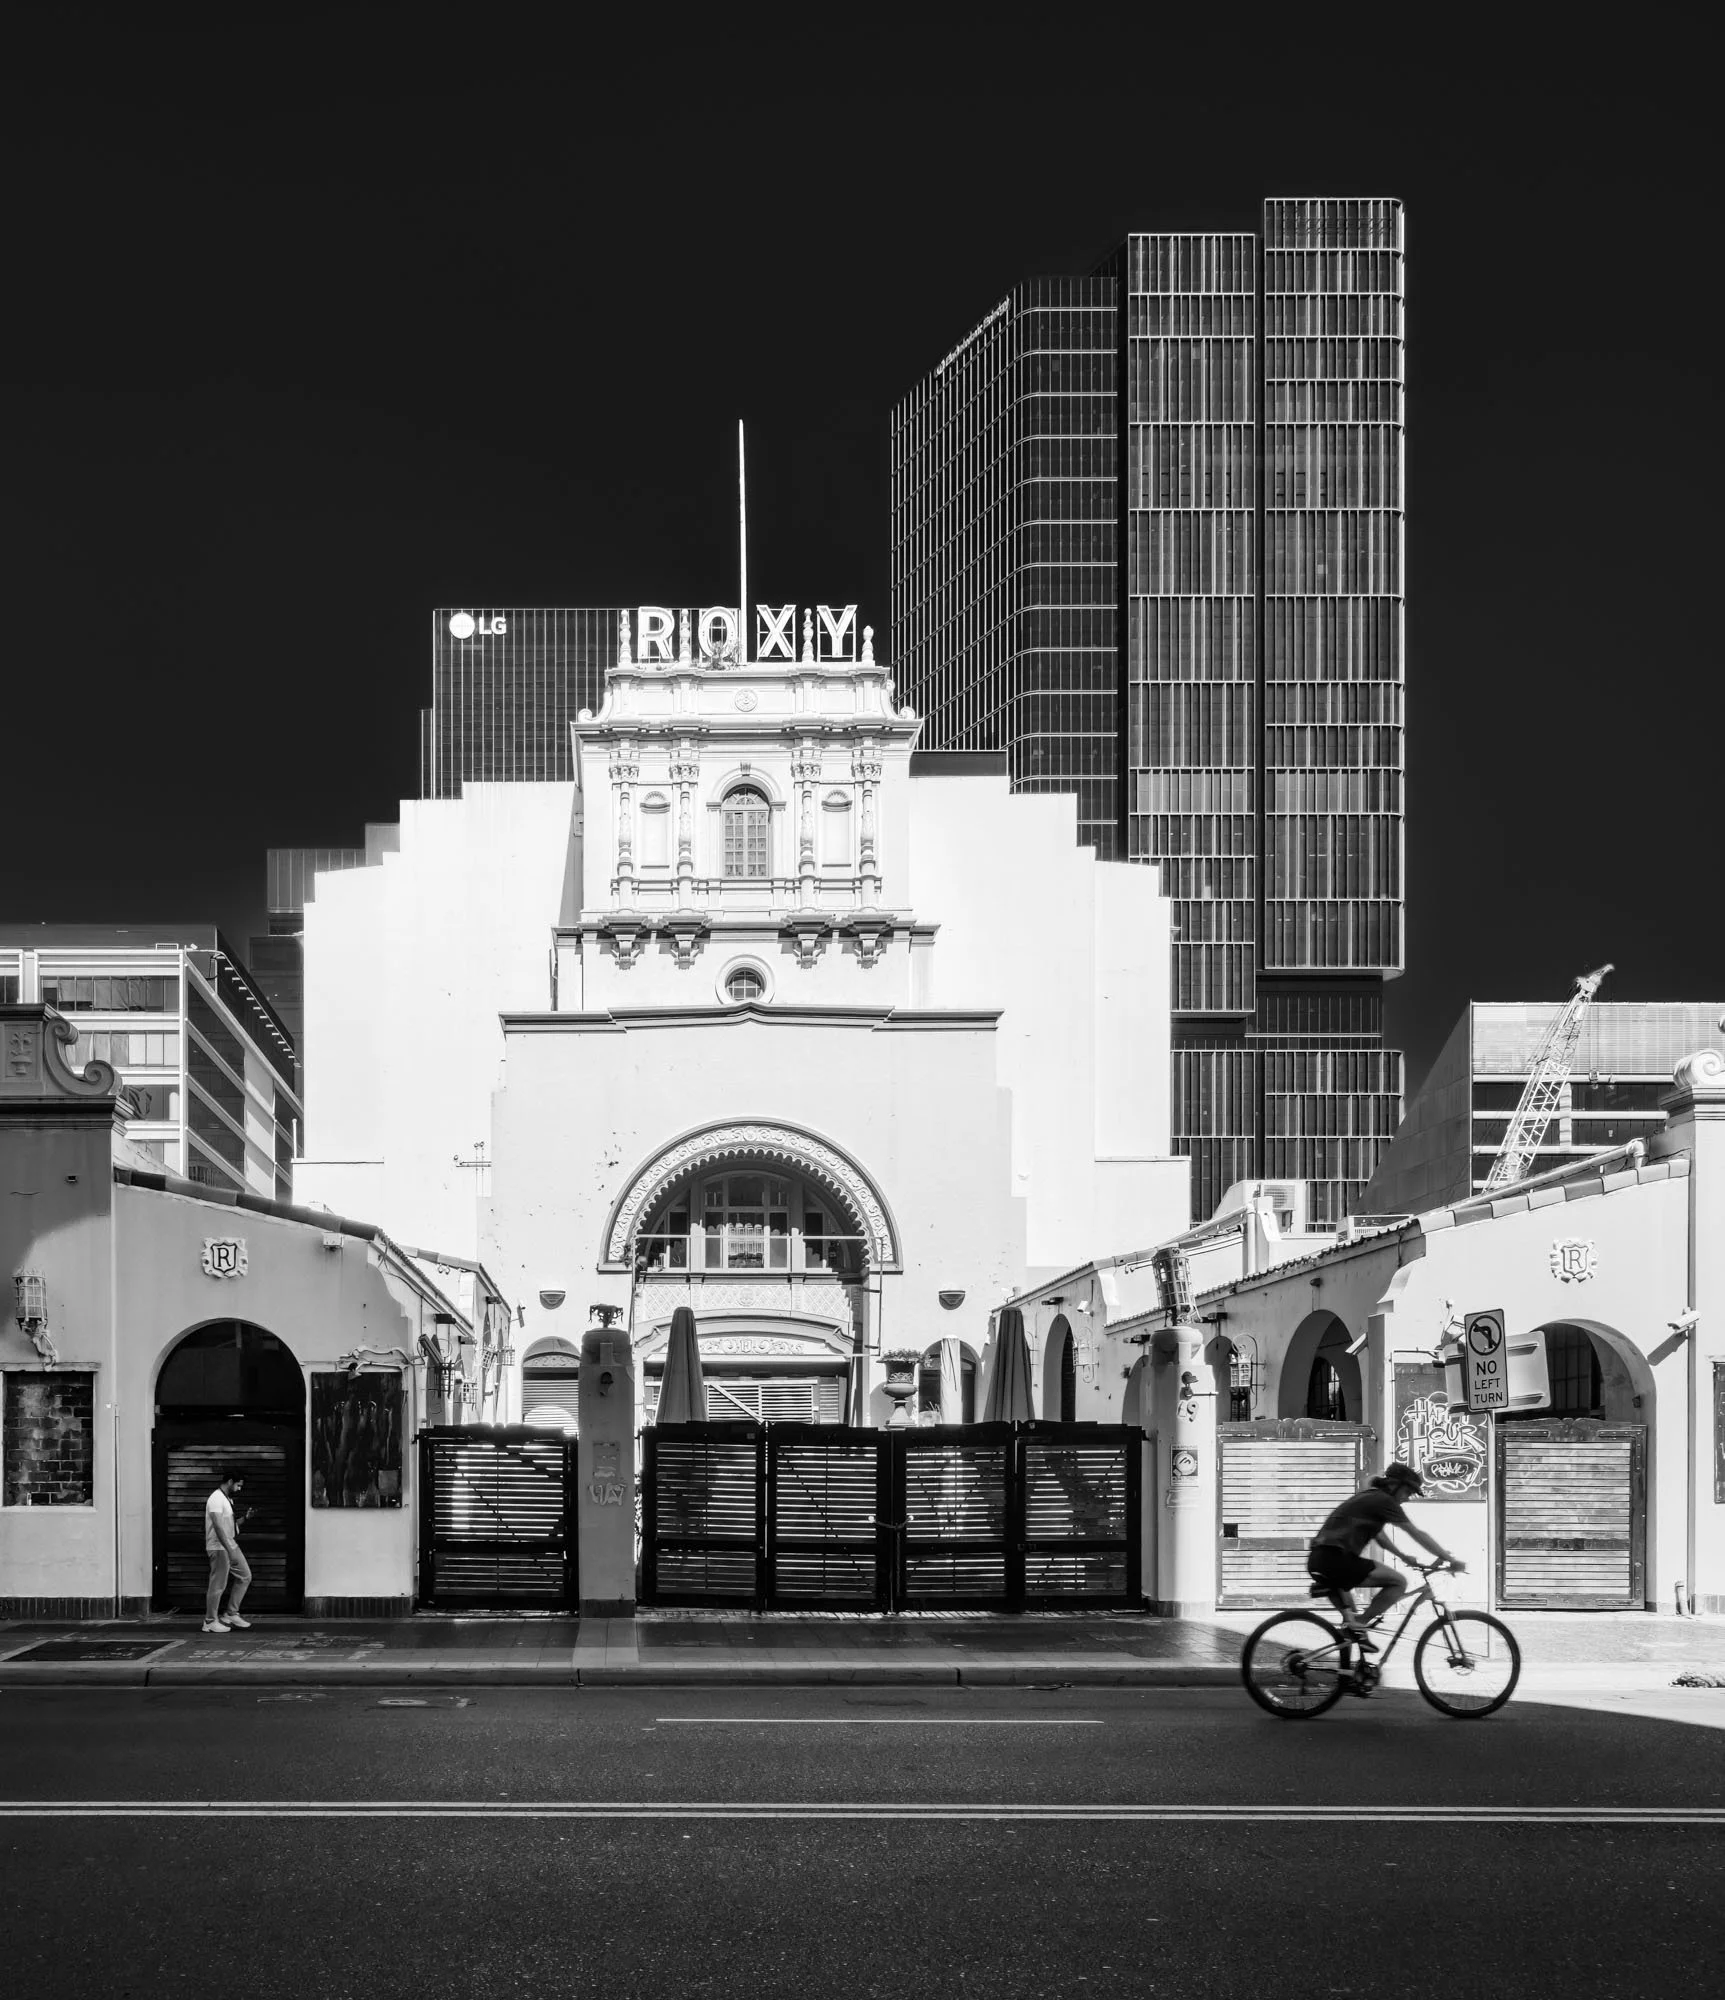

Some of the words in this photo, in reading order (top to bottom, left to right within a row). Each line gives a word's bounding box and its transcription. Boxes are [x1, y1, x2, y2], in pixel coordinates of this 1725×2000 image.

[478, 616, 507, 635] LG
[637, 604, 858, 660] ROXY
[217, 1247, 231, 1268] R
[1568, 1249, 1583, 1270] R
[1476, 1360, 1497, 1376] NO
[1474, 1377, 1501, 1390] LEFT
[1474, 1391, 1503, 1404] TURN
